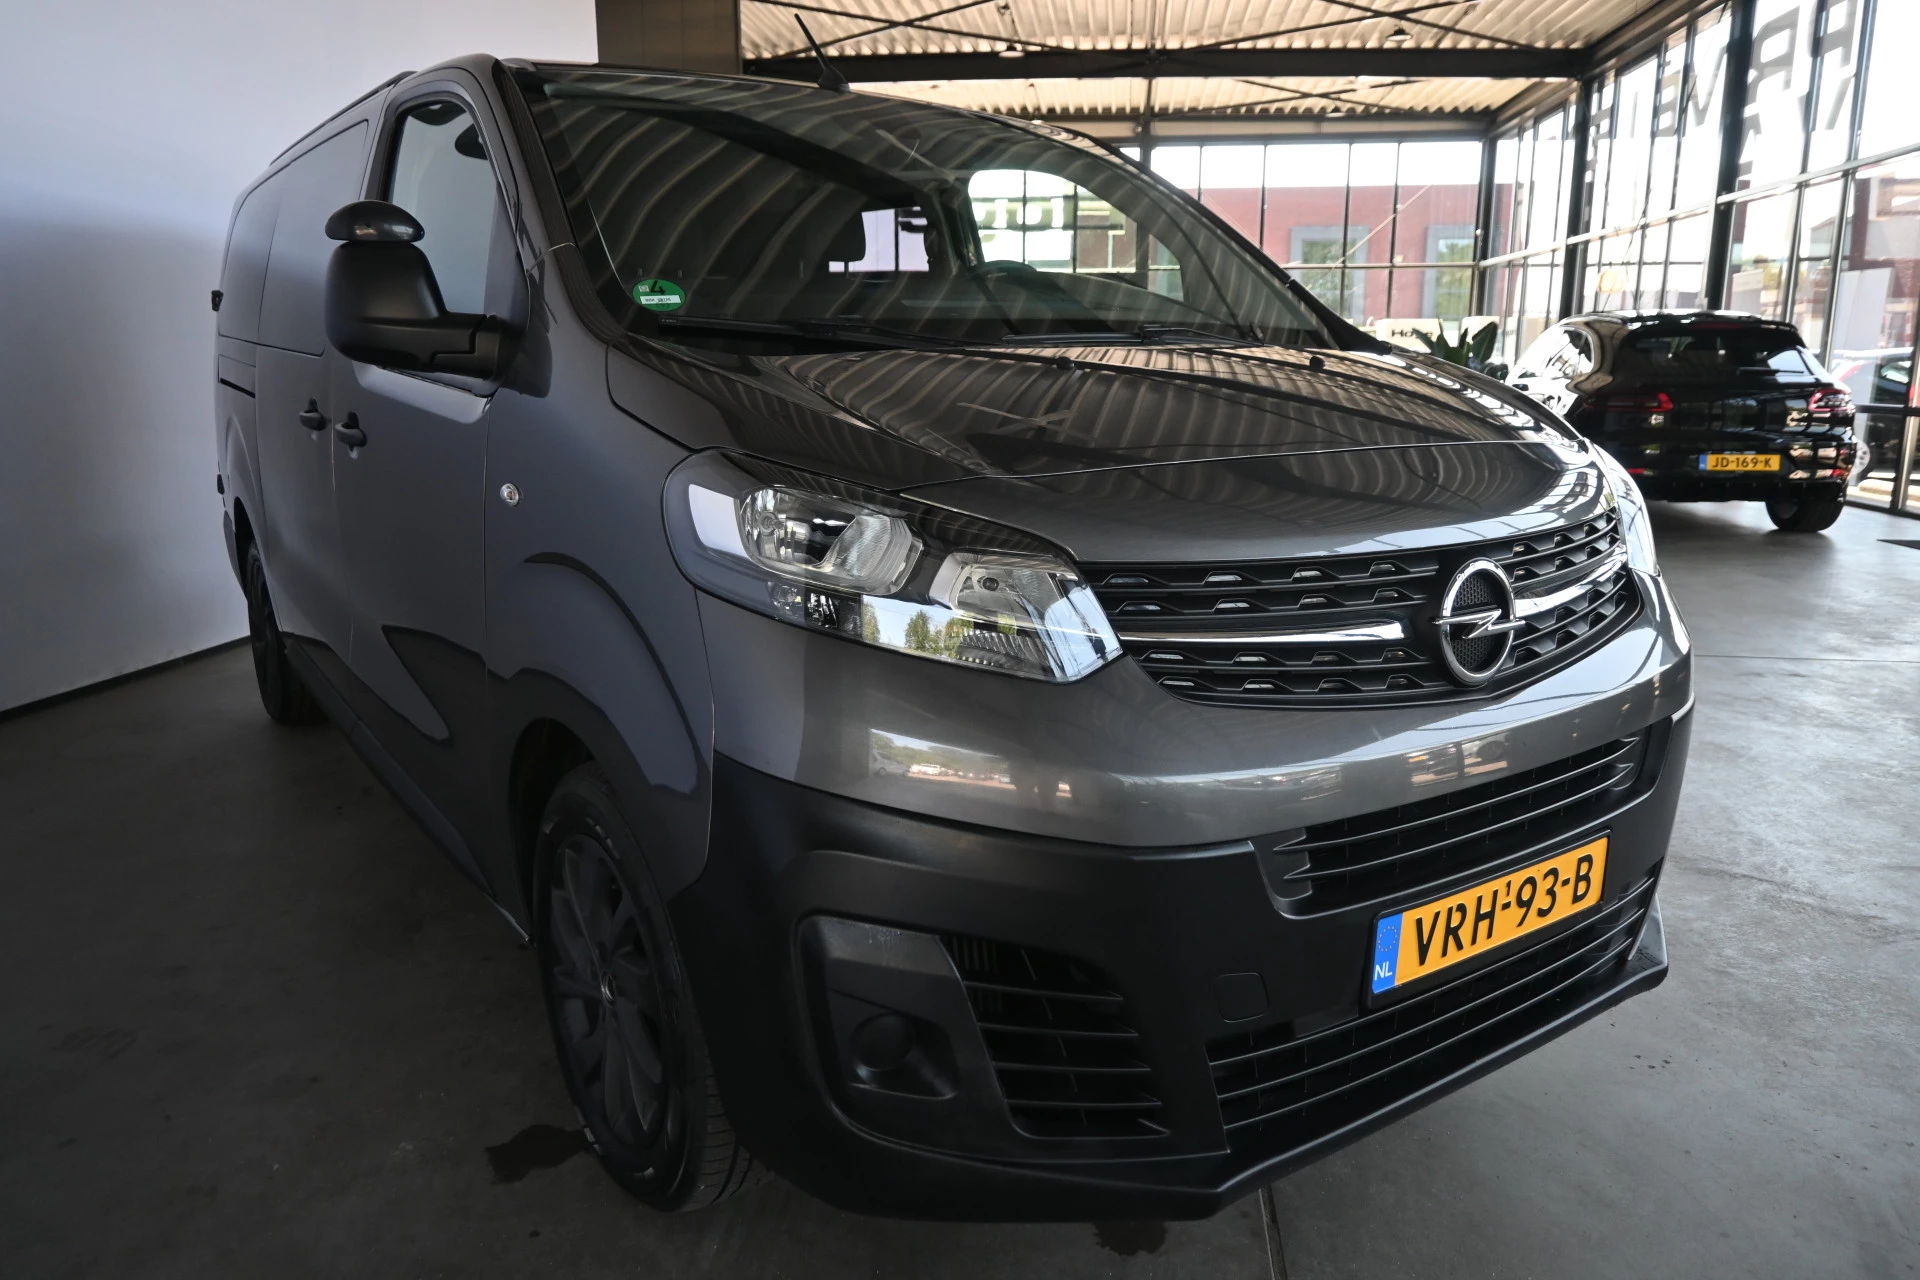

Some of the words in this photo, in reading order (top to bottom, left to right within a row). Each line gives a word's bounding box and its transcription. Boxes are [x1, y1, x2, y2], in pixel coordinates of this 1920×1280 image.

[1712, 456, 1772, 469] JD-169-K
[1374, 961, 1393, 981] NL
[1415, 853, 1594, 966] VRH-93-B
